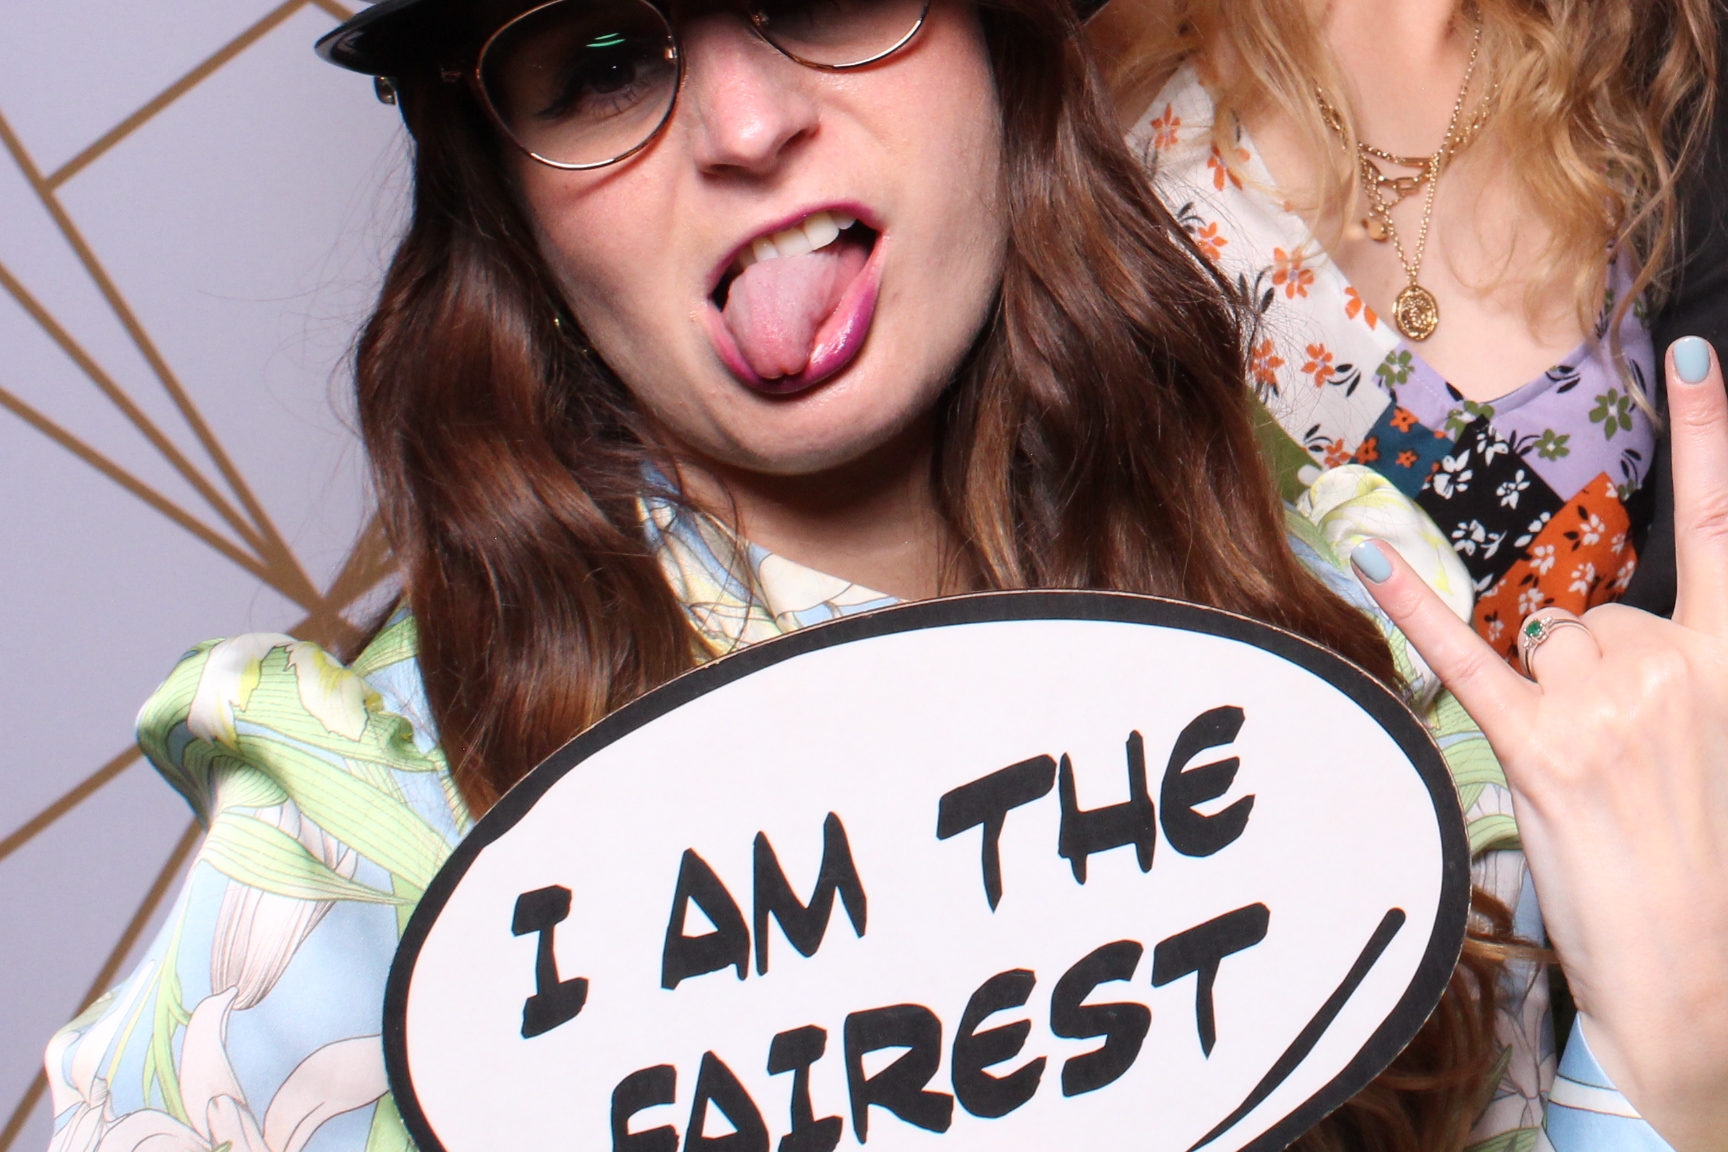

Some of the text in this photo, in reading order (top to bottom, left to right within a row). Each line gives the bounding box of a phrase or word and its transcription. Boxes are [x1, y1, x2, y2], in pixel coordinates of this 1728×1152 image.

[511, 705, 1256, 1038] I AM THE
[610, 902, 1270, 1152] FAIREST
